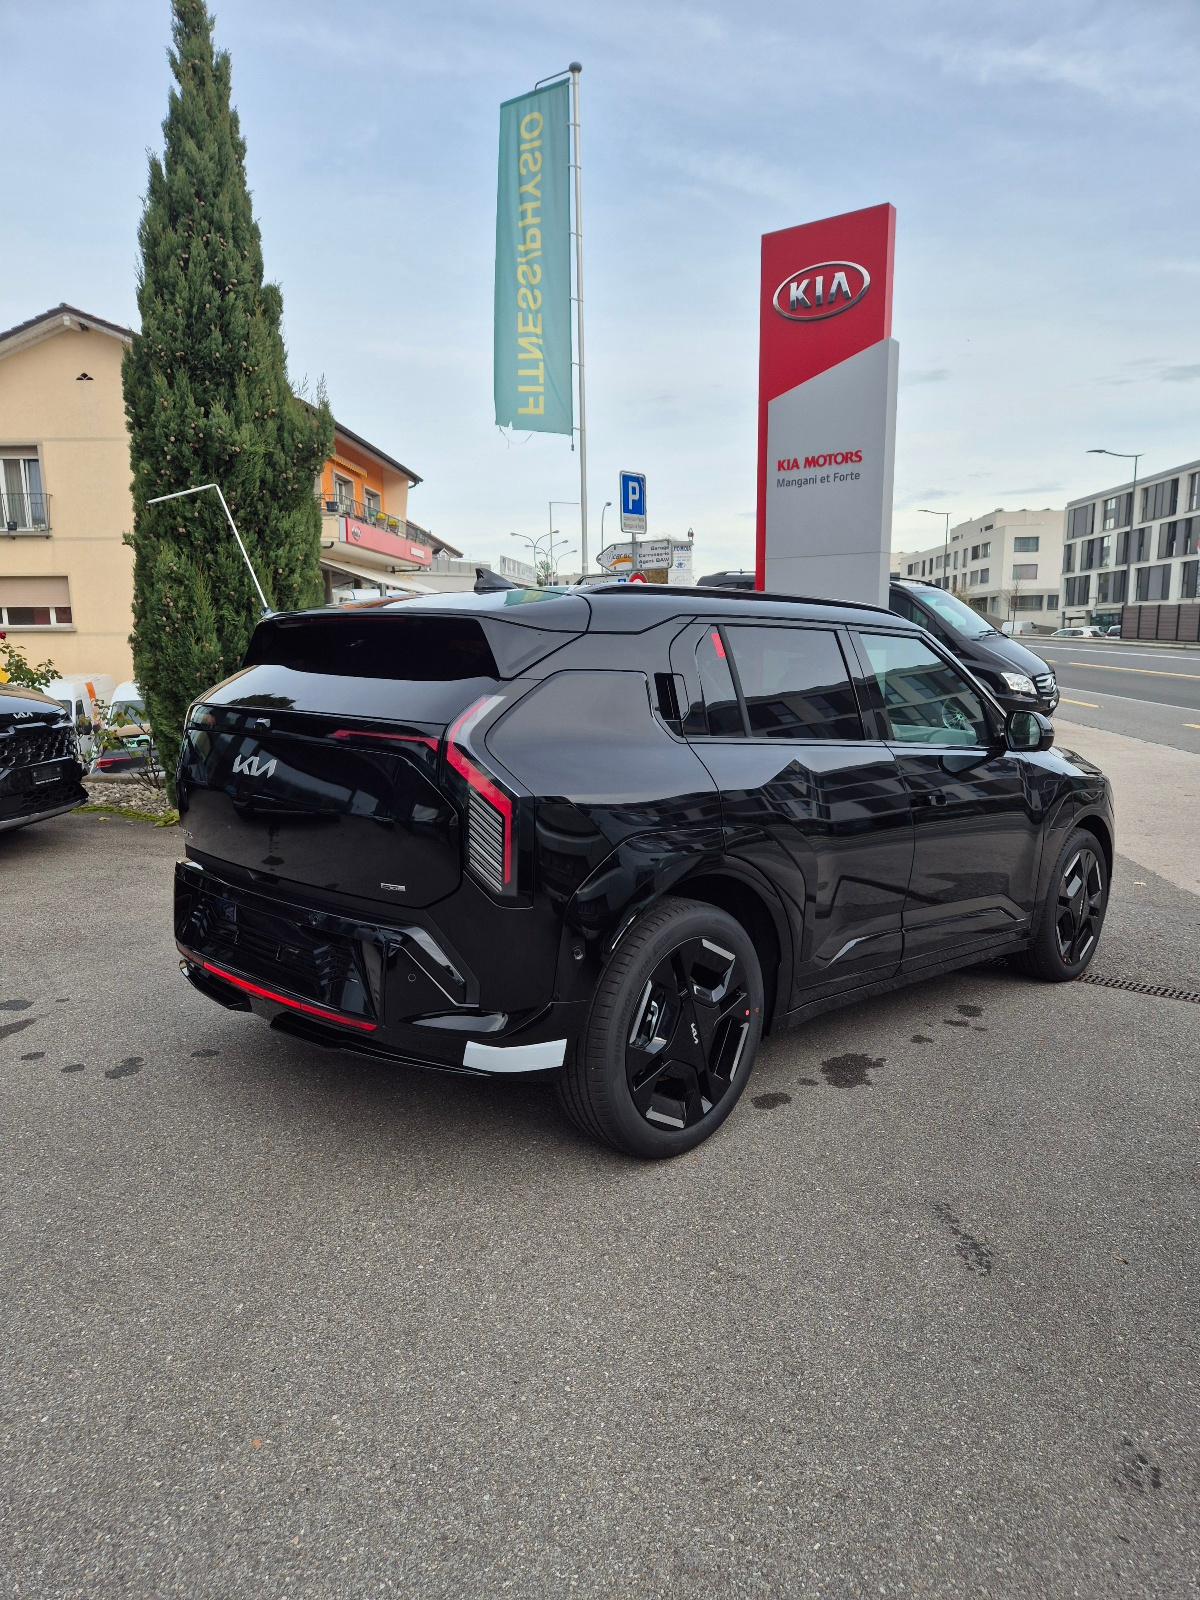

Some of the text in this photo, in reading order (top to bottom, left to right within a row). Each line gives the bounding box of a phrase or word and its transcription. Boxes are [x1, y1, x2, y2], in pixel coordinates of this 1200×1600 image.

[789, 271, 852, 310] KIA
[777, 450, 863, 471] KIA MOTORS
[776, 471, 861, 488] Mangani et Forte
[628, 480, 640, 510] P
[232, 754, 277, 778] KIA
